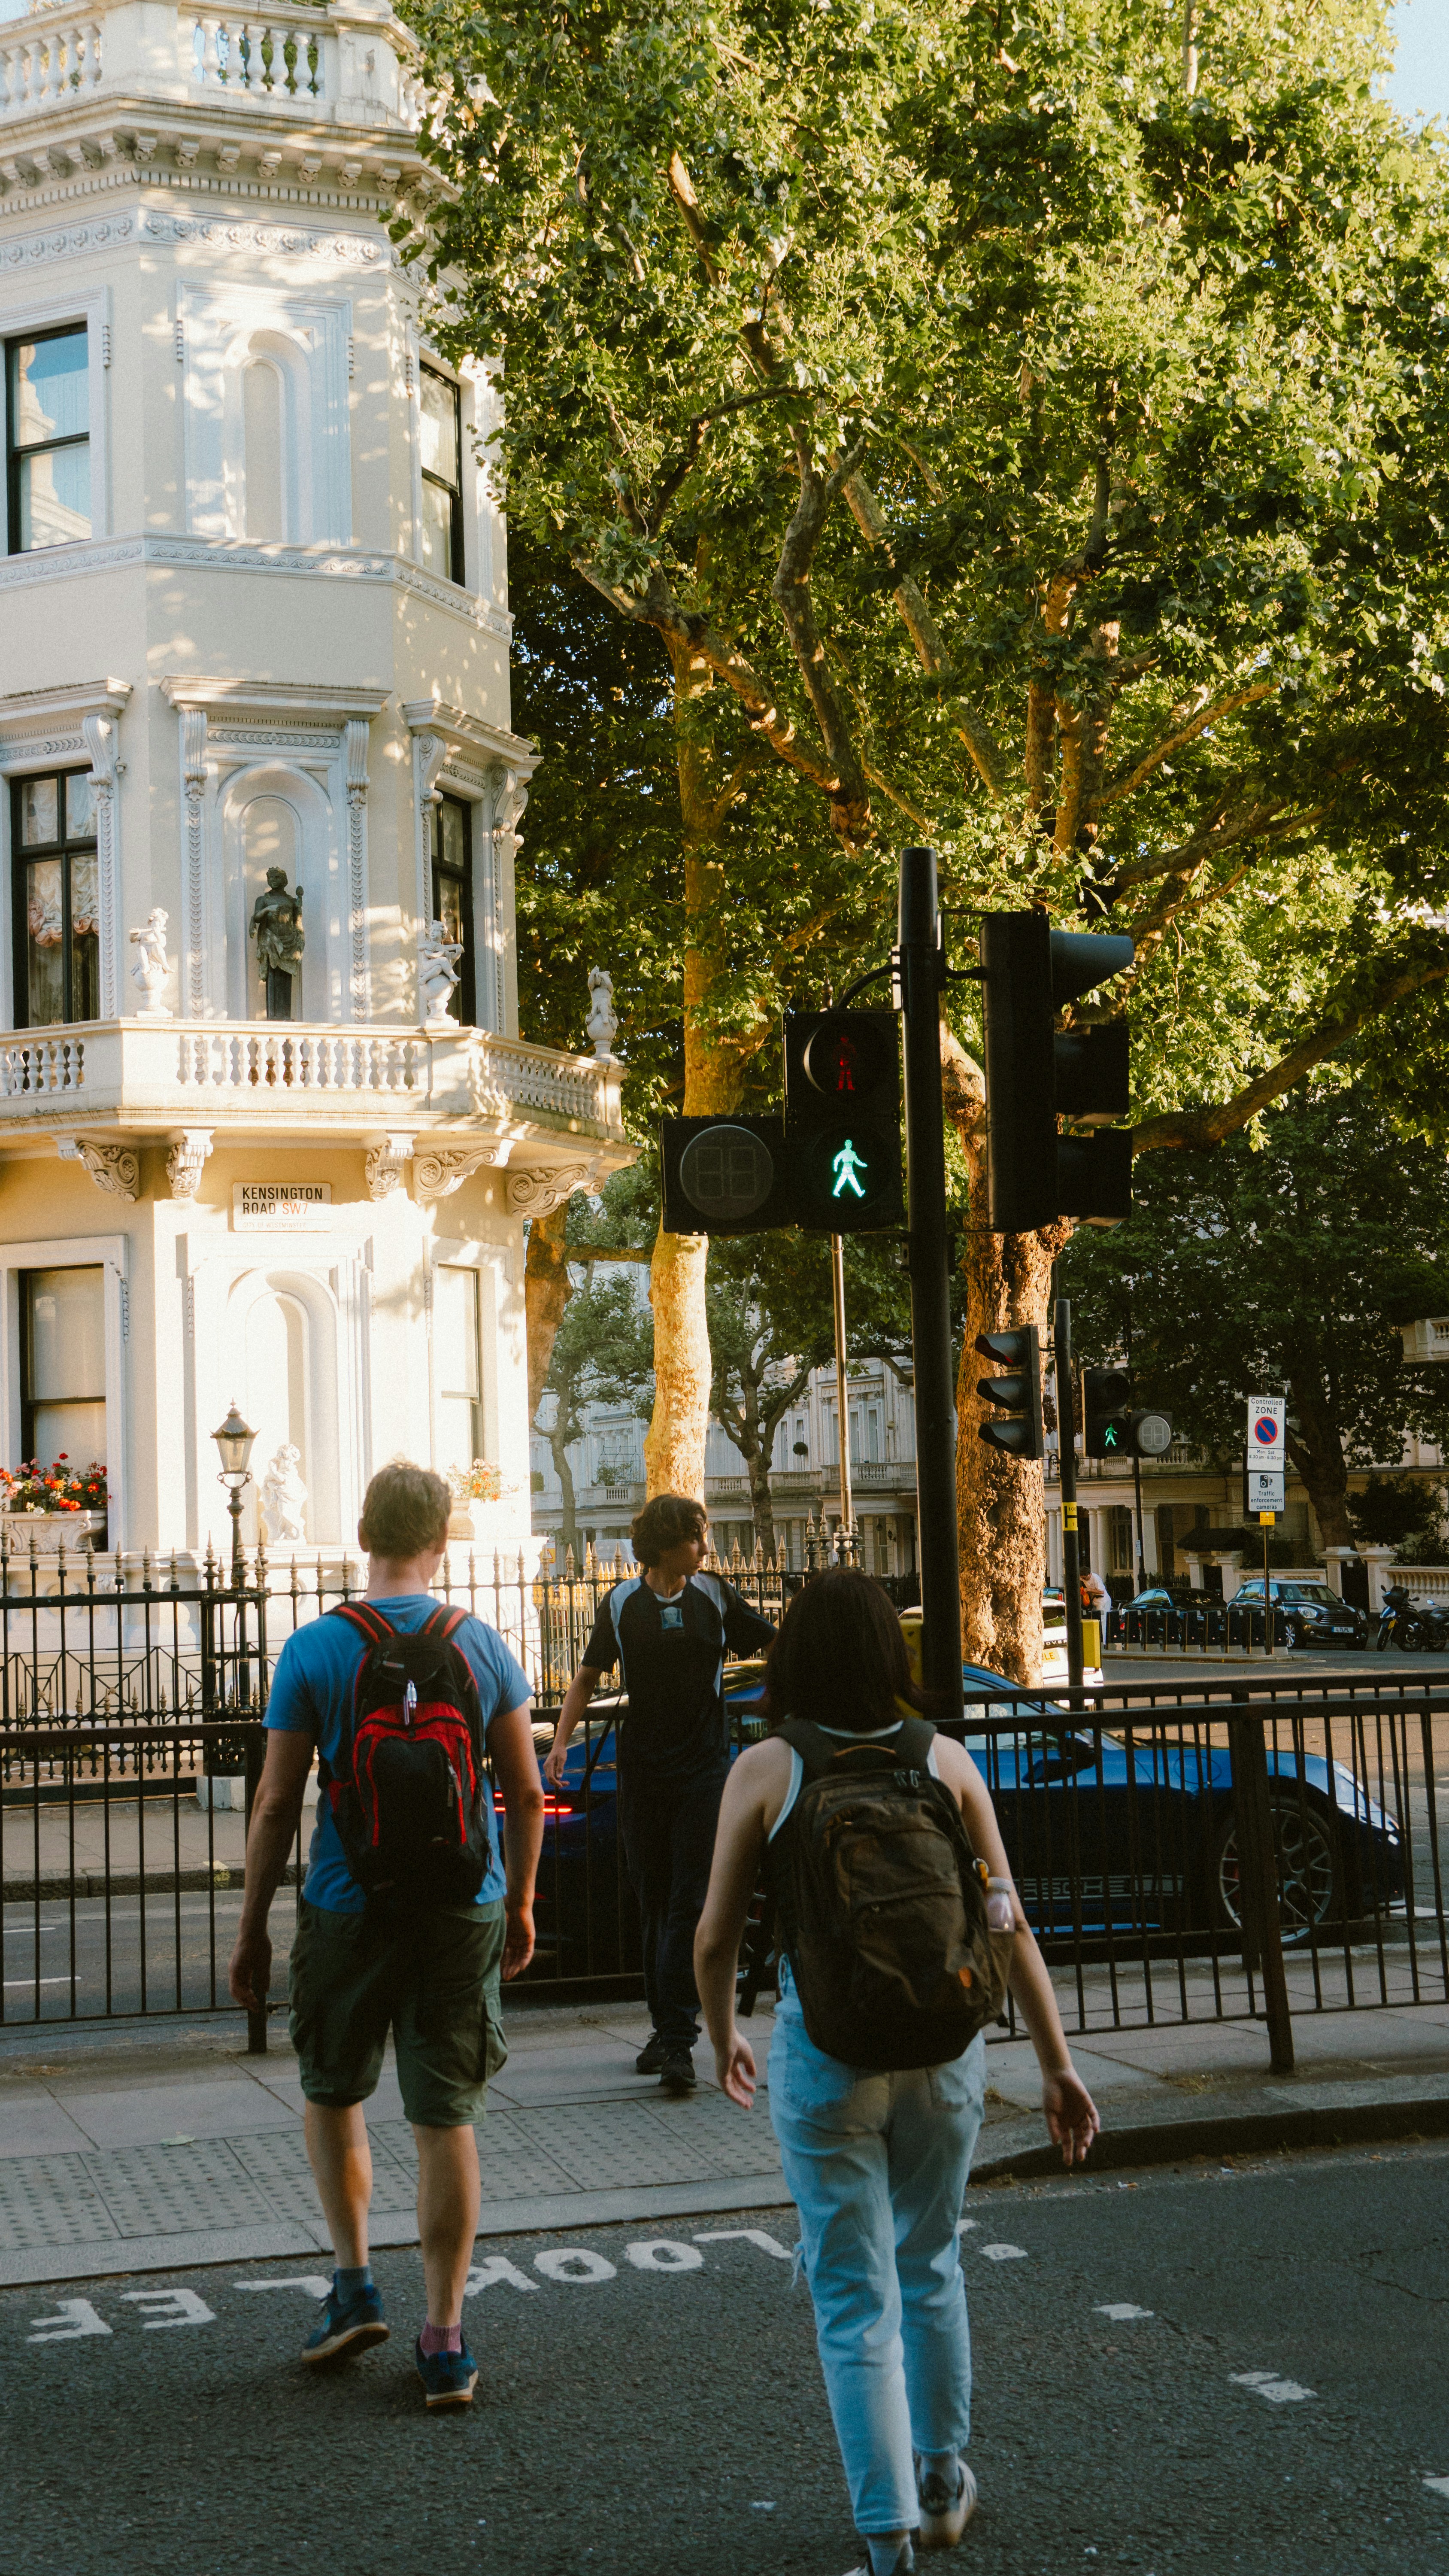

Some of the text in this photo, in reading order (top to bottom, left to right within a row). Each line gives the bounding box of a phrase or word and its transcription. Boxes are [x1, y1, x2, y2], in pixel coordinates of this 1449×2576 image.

[243, 1187, 322, 1200] KENSINGTON
[243, 1202, 308, 1215] ROAD SW7
[463, 2229, 793, 2297] LOOK
